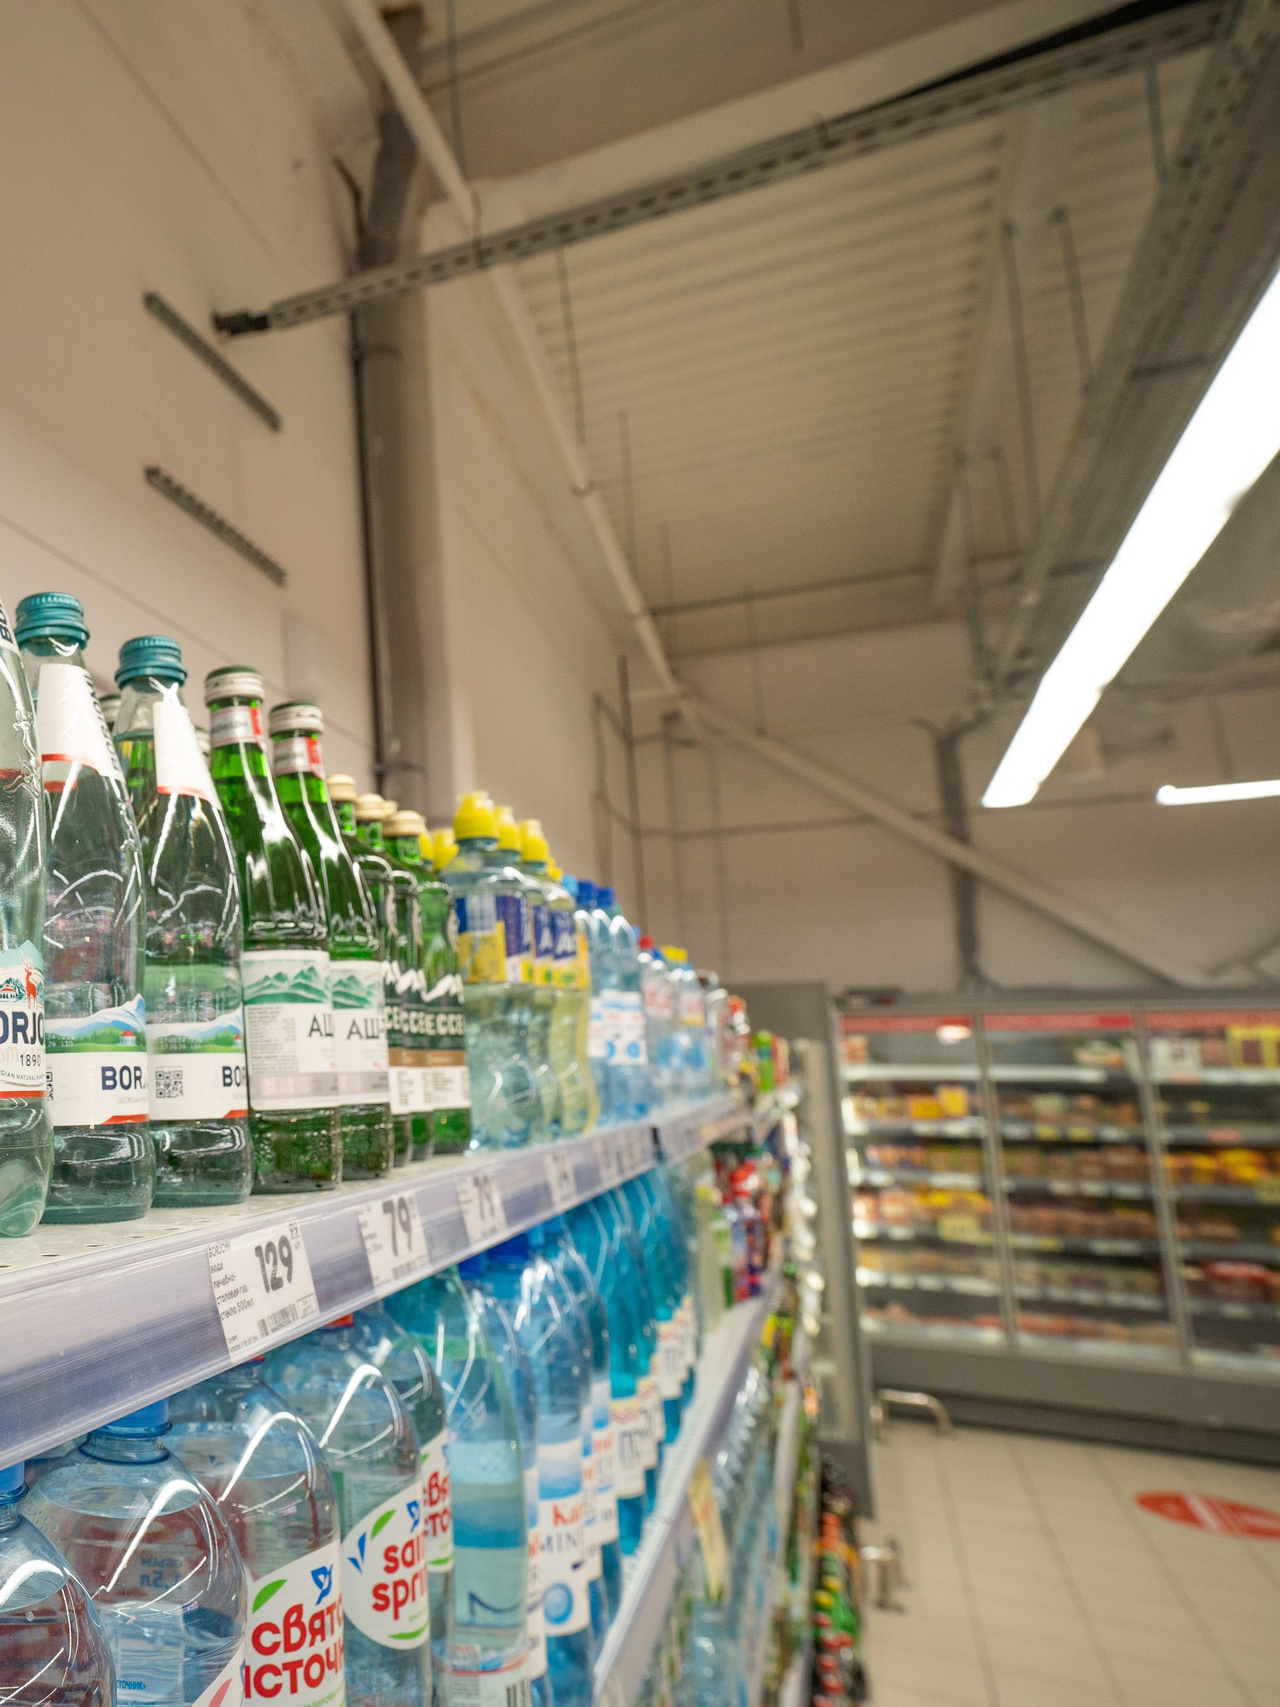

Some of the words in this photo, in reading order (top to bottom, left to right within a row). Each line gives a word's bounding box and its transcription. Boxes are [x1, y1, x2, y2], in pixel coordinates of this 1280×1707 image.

[20, 1054, 41, 1067] 1890
[382, 1196, 412, 1257] 79
[255, 1235, 293, 1293] 129
